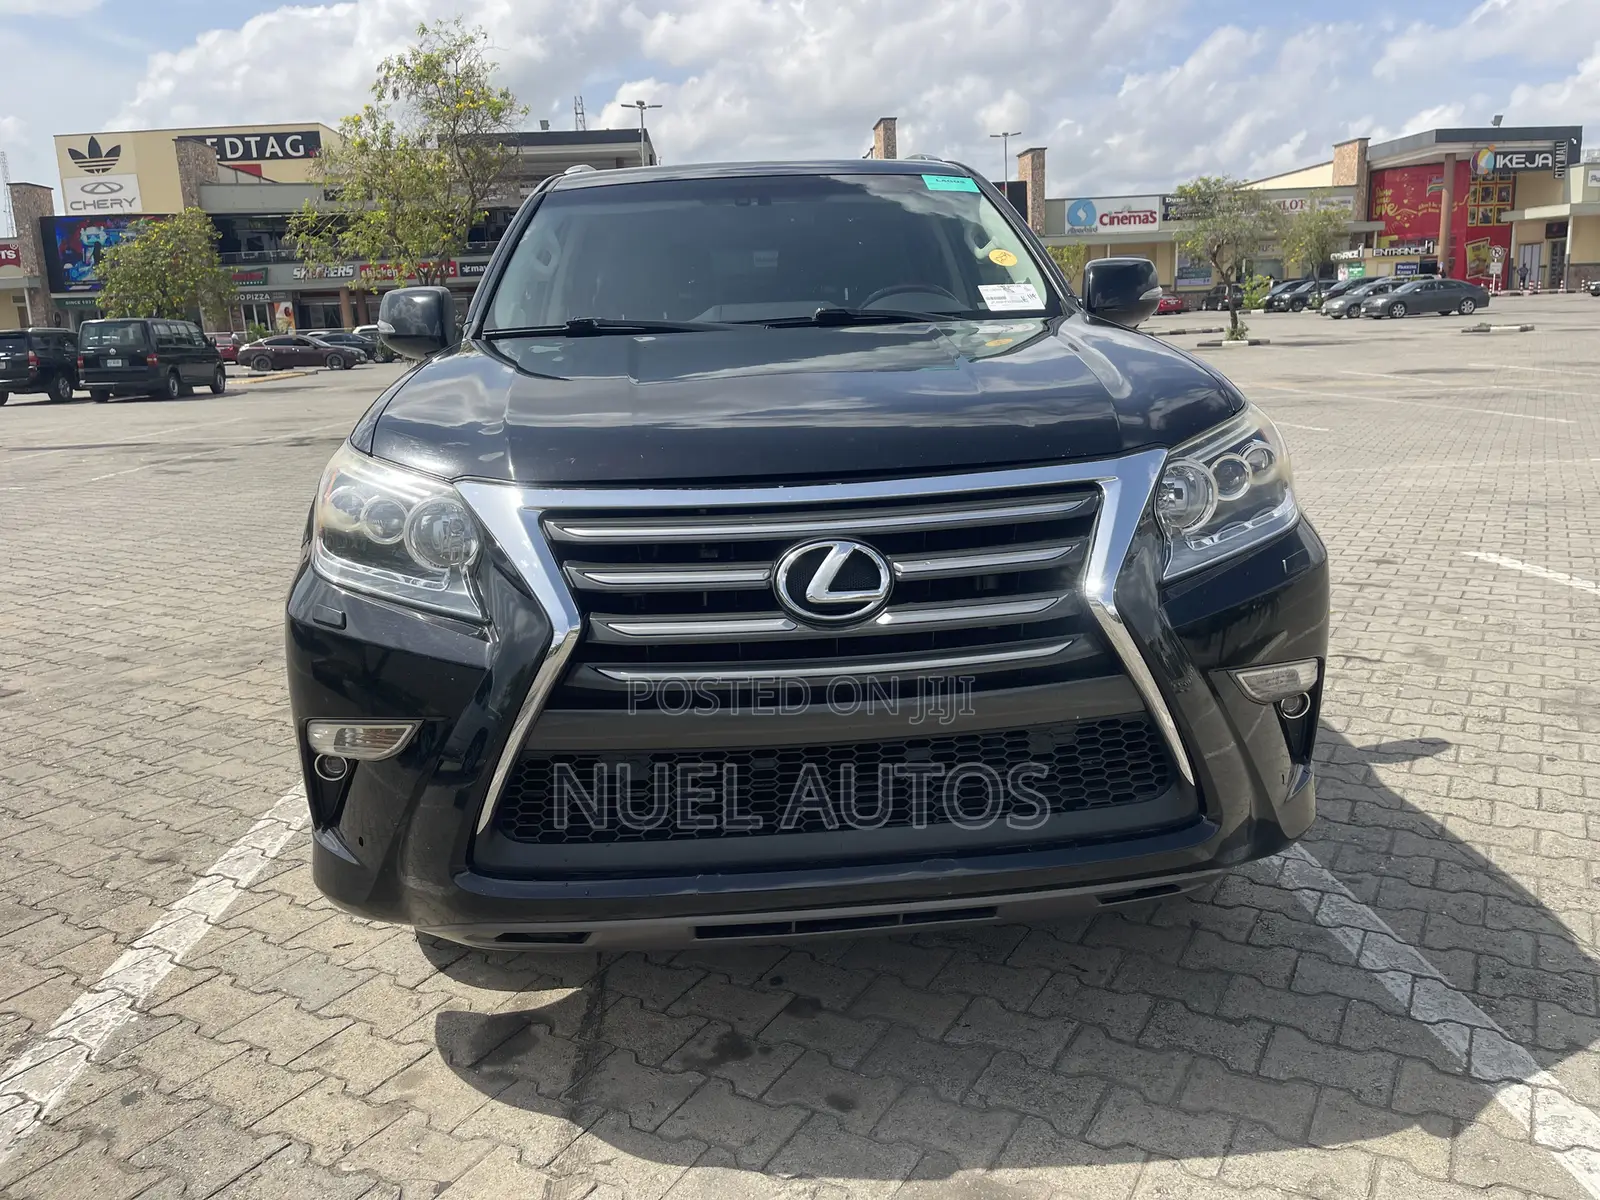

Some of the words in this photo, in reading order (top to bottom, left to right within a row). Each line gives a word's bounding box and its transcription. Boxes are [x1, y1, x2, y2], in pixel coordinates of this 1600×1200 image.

[205, 135, 305, 159] EDTAG
[1556, 141, 1567, 162] MALL
[1496, 153, 1552, 168] IKEJA
[69, 197, 136, 211] CHERY
[1099, 210, 1157, 226] Cinemas
[1373, 248, 1425, 257] ENTRANCE
[1425, 240, 1435, 254] 1
